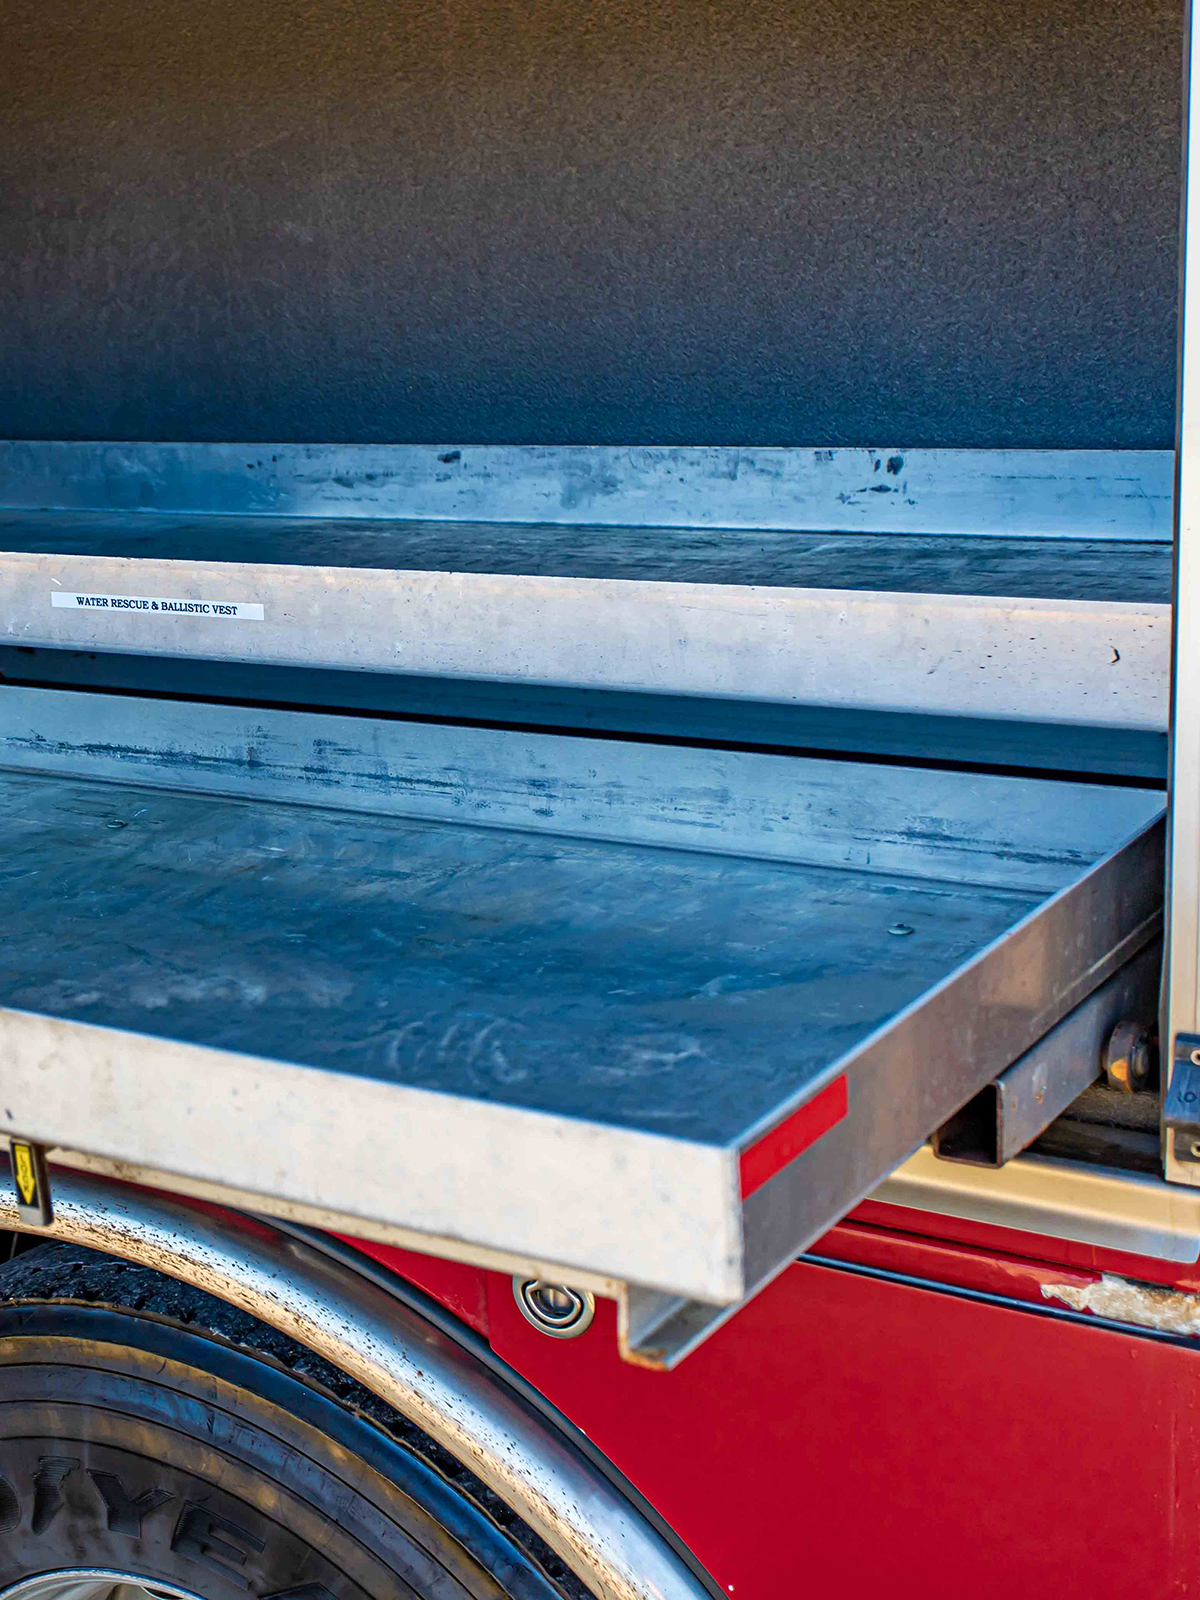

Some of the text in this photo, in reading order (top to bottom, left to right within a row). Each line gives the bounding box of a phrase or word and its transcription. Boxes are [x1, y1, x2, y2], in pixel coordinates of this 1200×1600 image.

[76, 596, 238, 615] WATER RESCUE & BALLISTIC VEST
